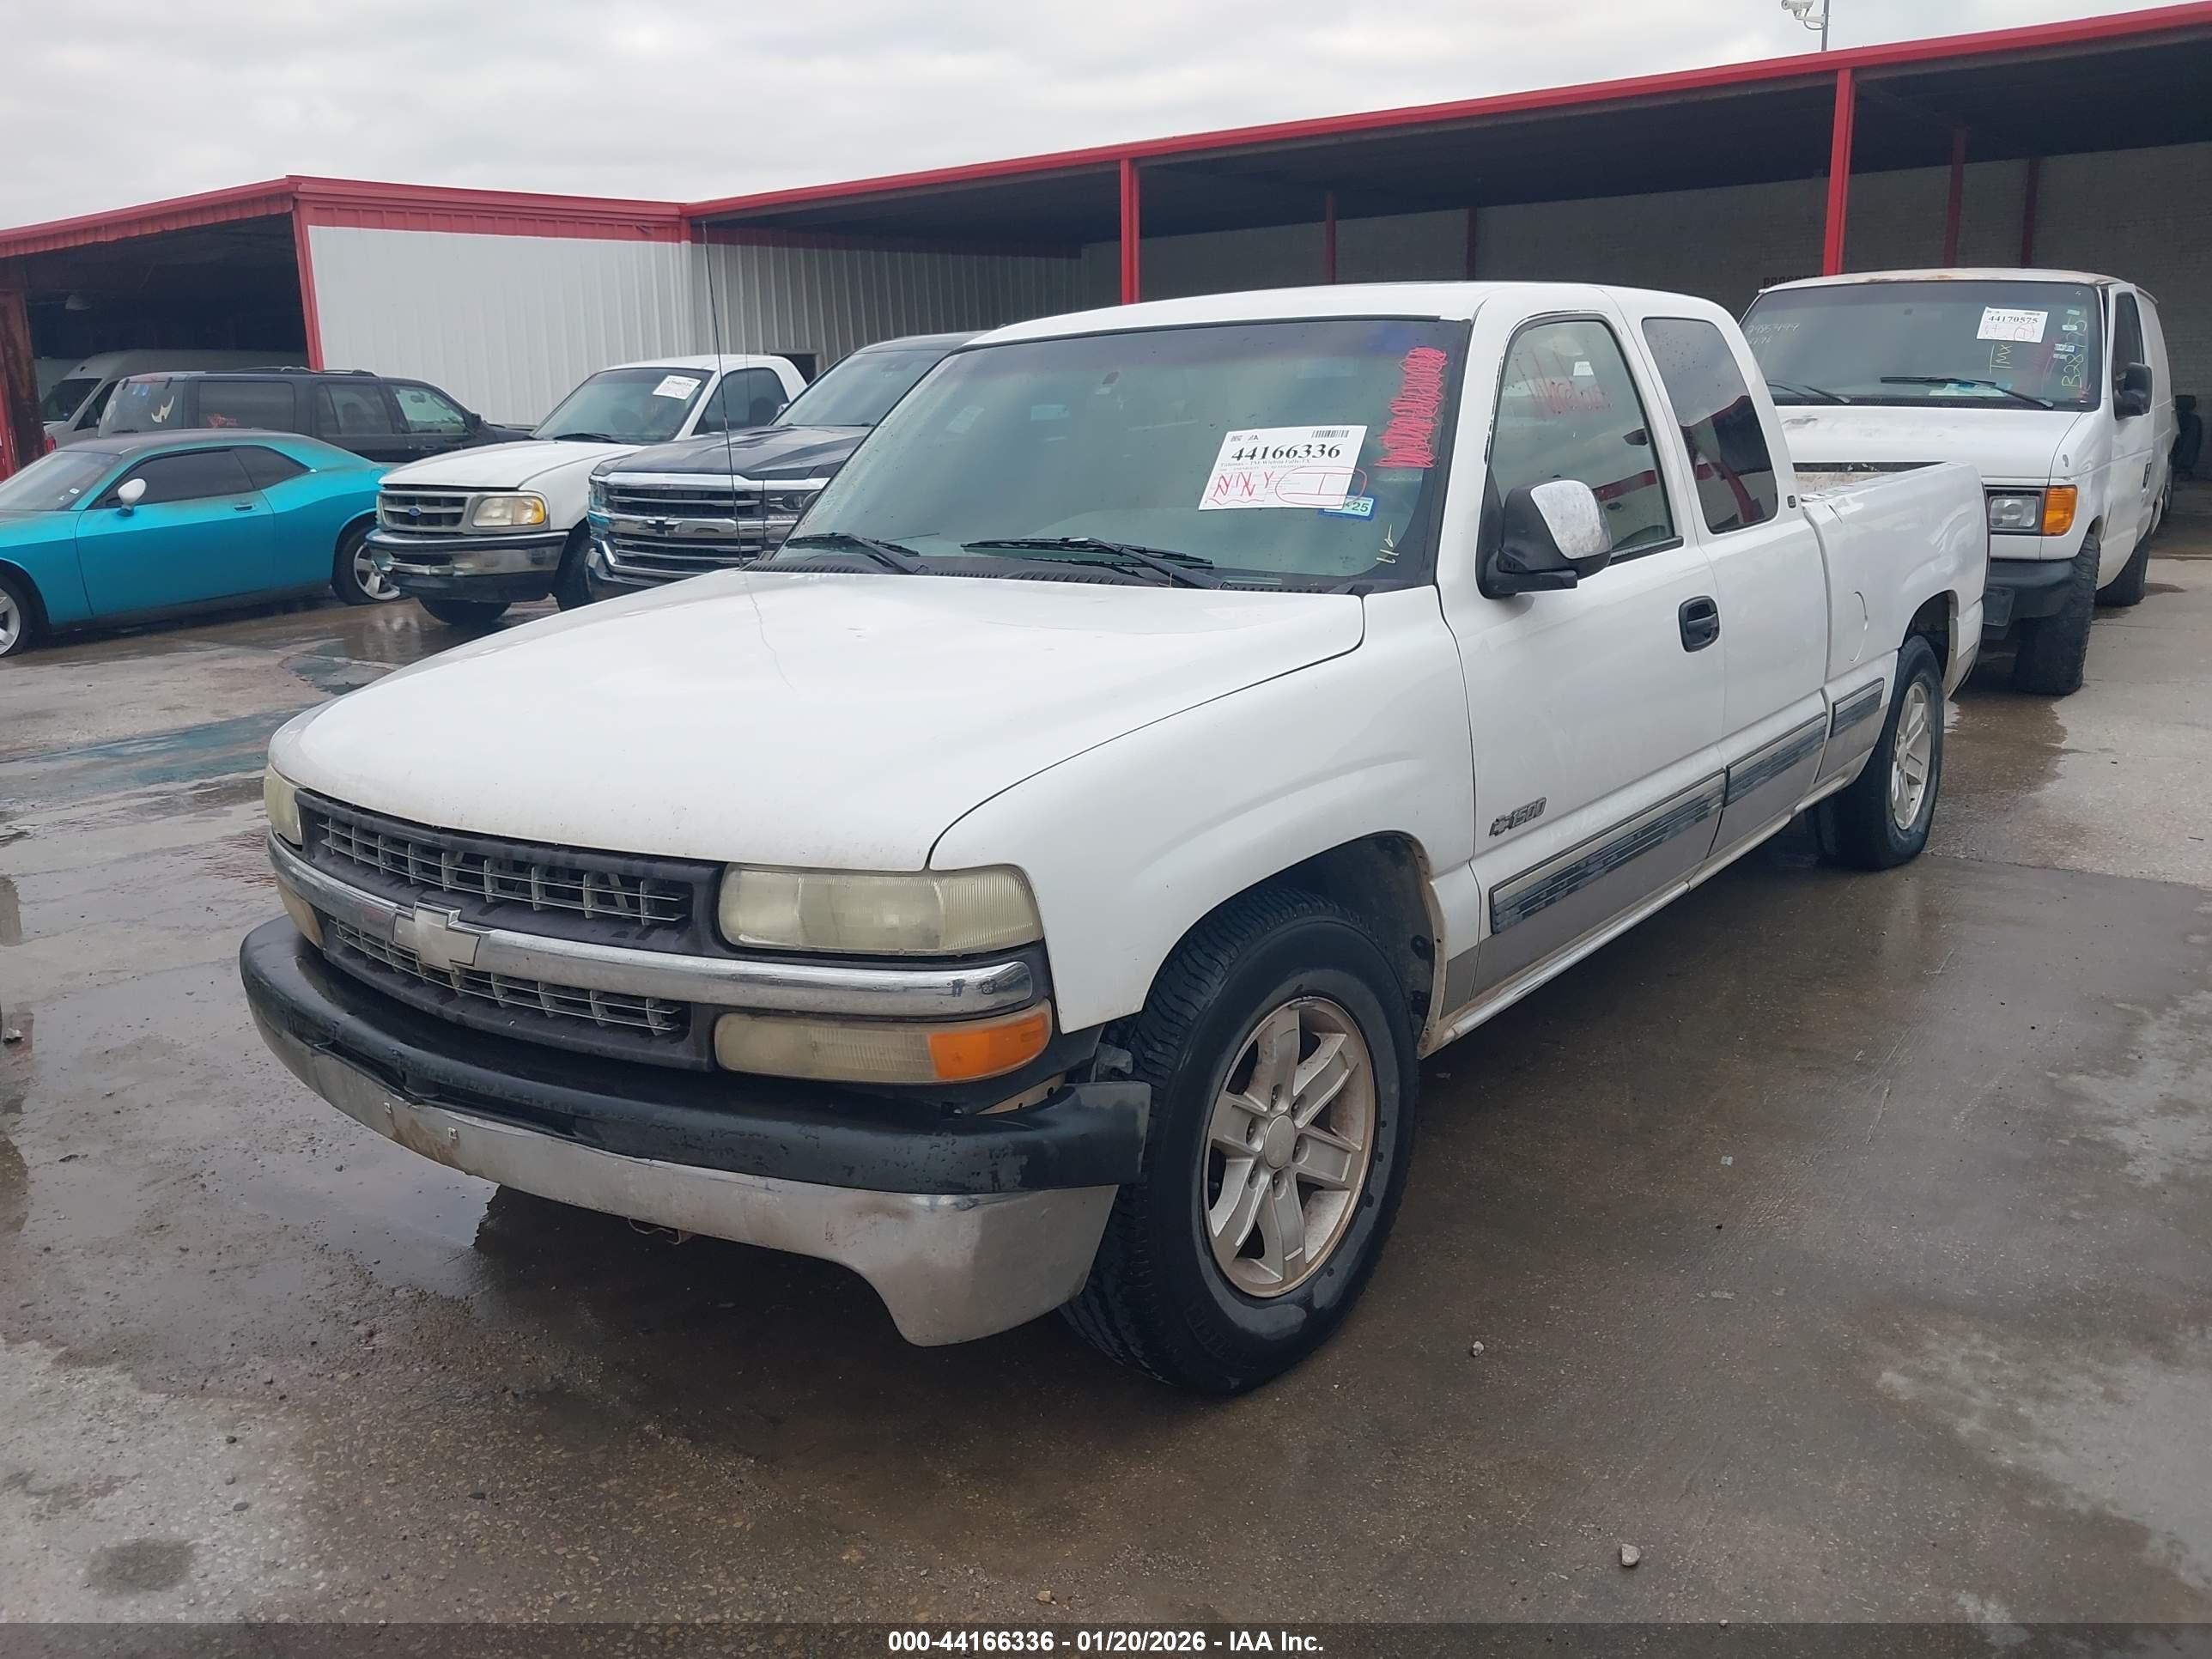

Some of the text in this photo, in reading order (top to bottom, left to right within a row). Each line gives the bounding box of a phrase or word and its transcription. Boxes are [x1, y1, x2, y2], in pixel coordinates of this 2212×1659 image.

[1988, 315, 2039, 324] 44170575
[1231, 443, 1344, 462] 44166336
[1352, 501, 1369, 513] 25
